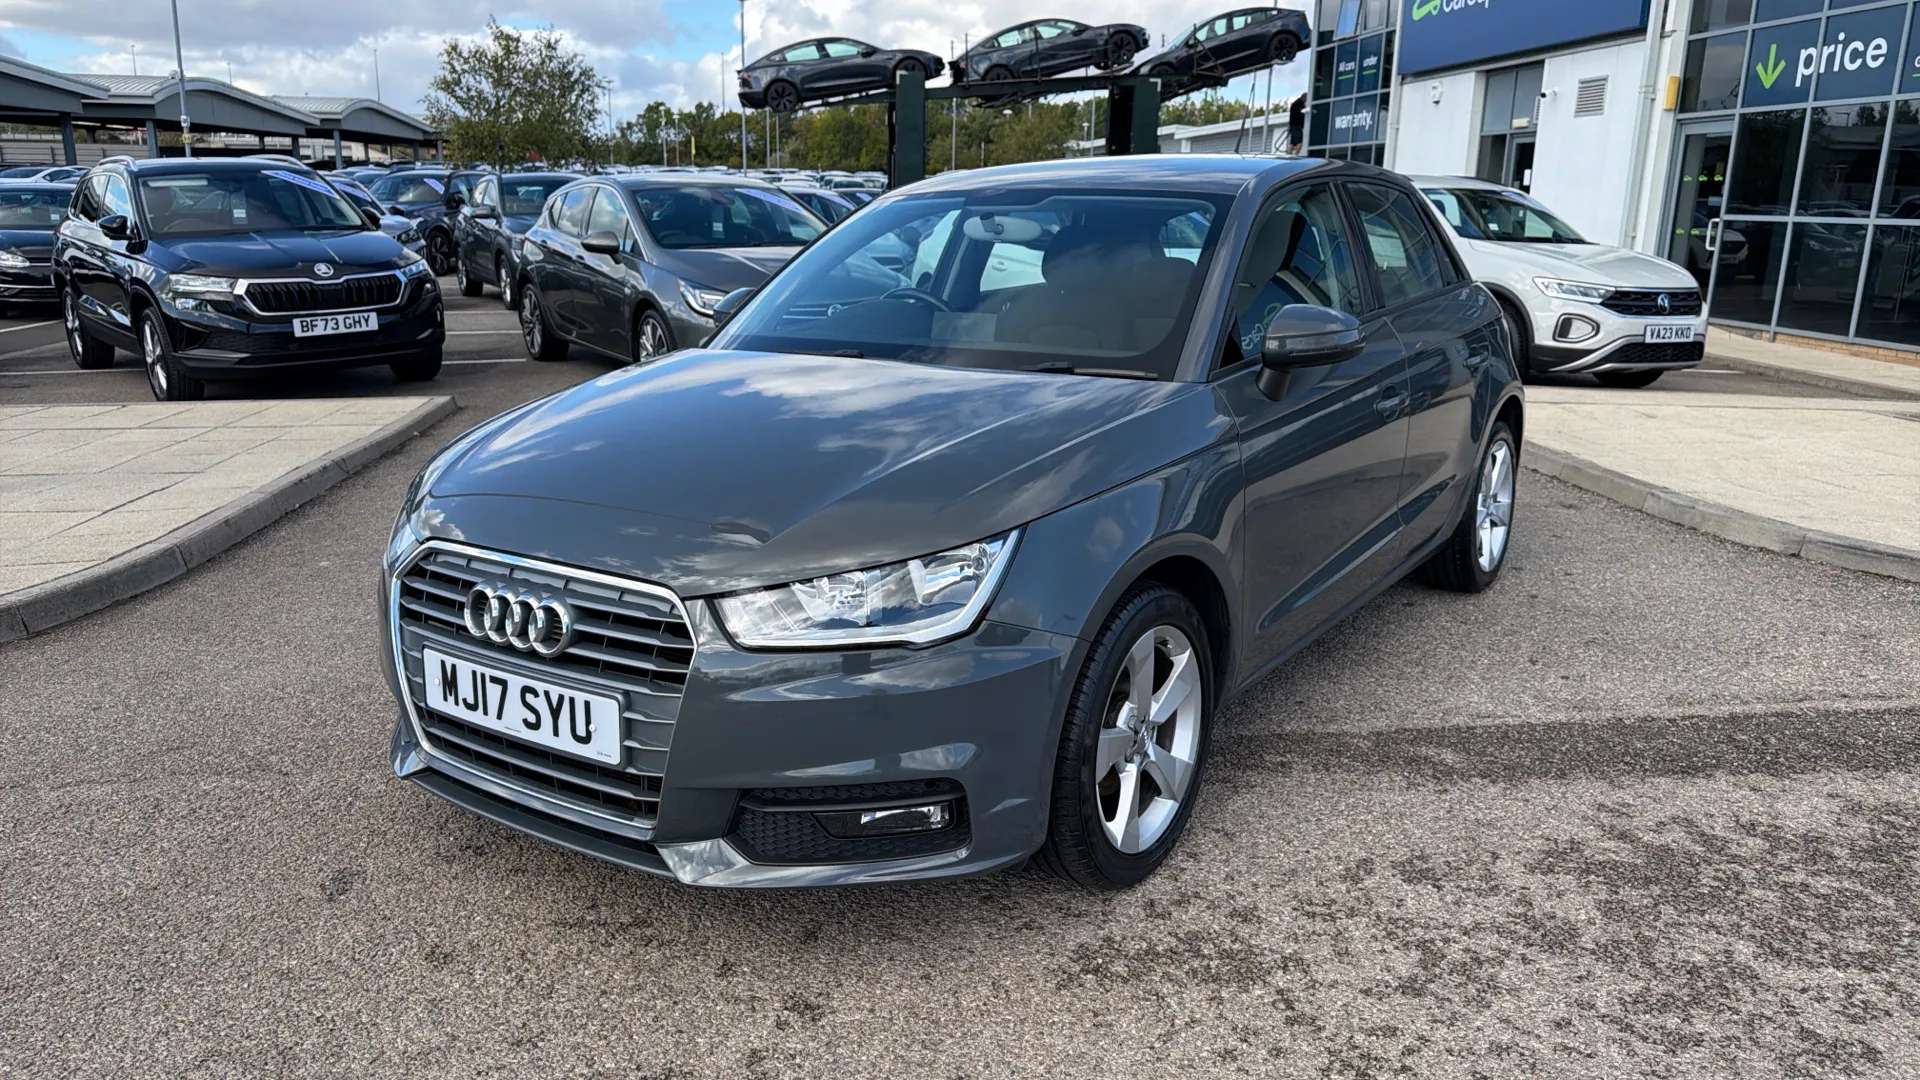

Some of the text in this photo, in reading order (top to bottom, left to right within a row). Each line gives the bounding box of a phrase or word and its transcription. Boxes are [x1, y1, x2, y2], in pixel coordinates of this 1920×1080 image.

[1795, 31, 1888, 87] price
[300, 314, 370, 333] BF73 GHY
[1650, 327, 1673, 340] VA23
[440, 659, 593, 745] MJ17 SYU
